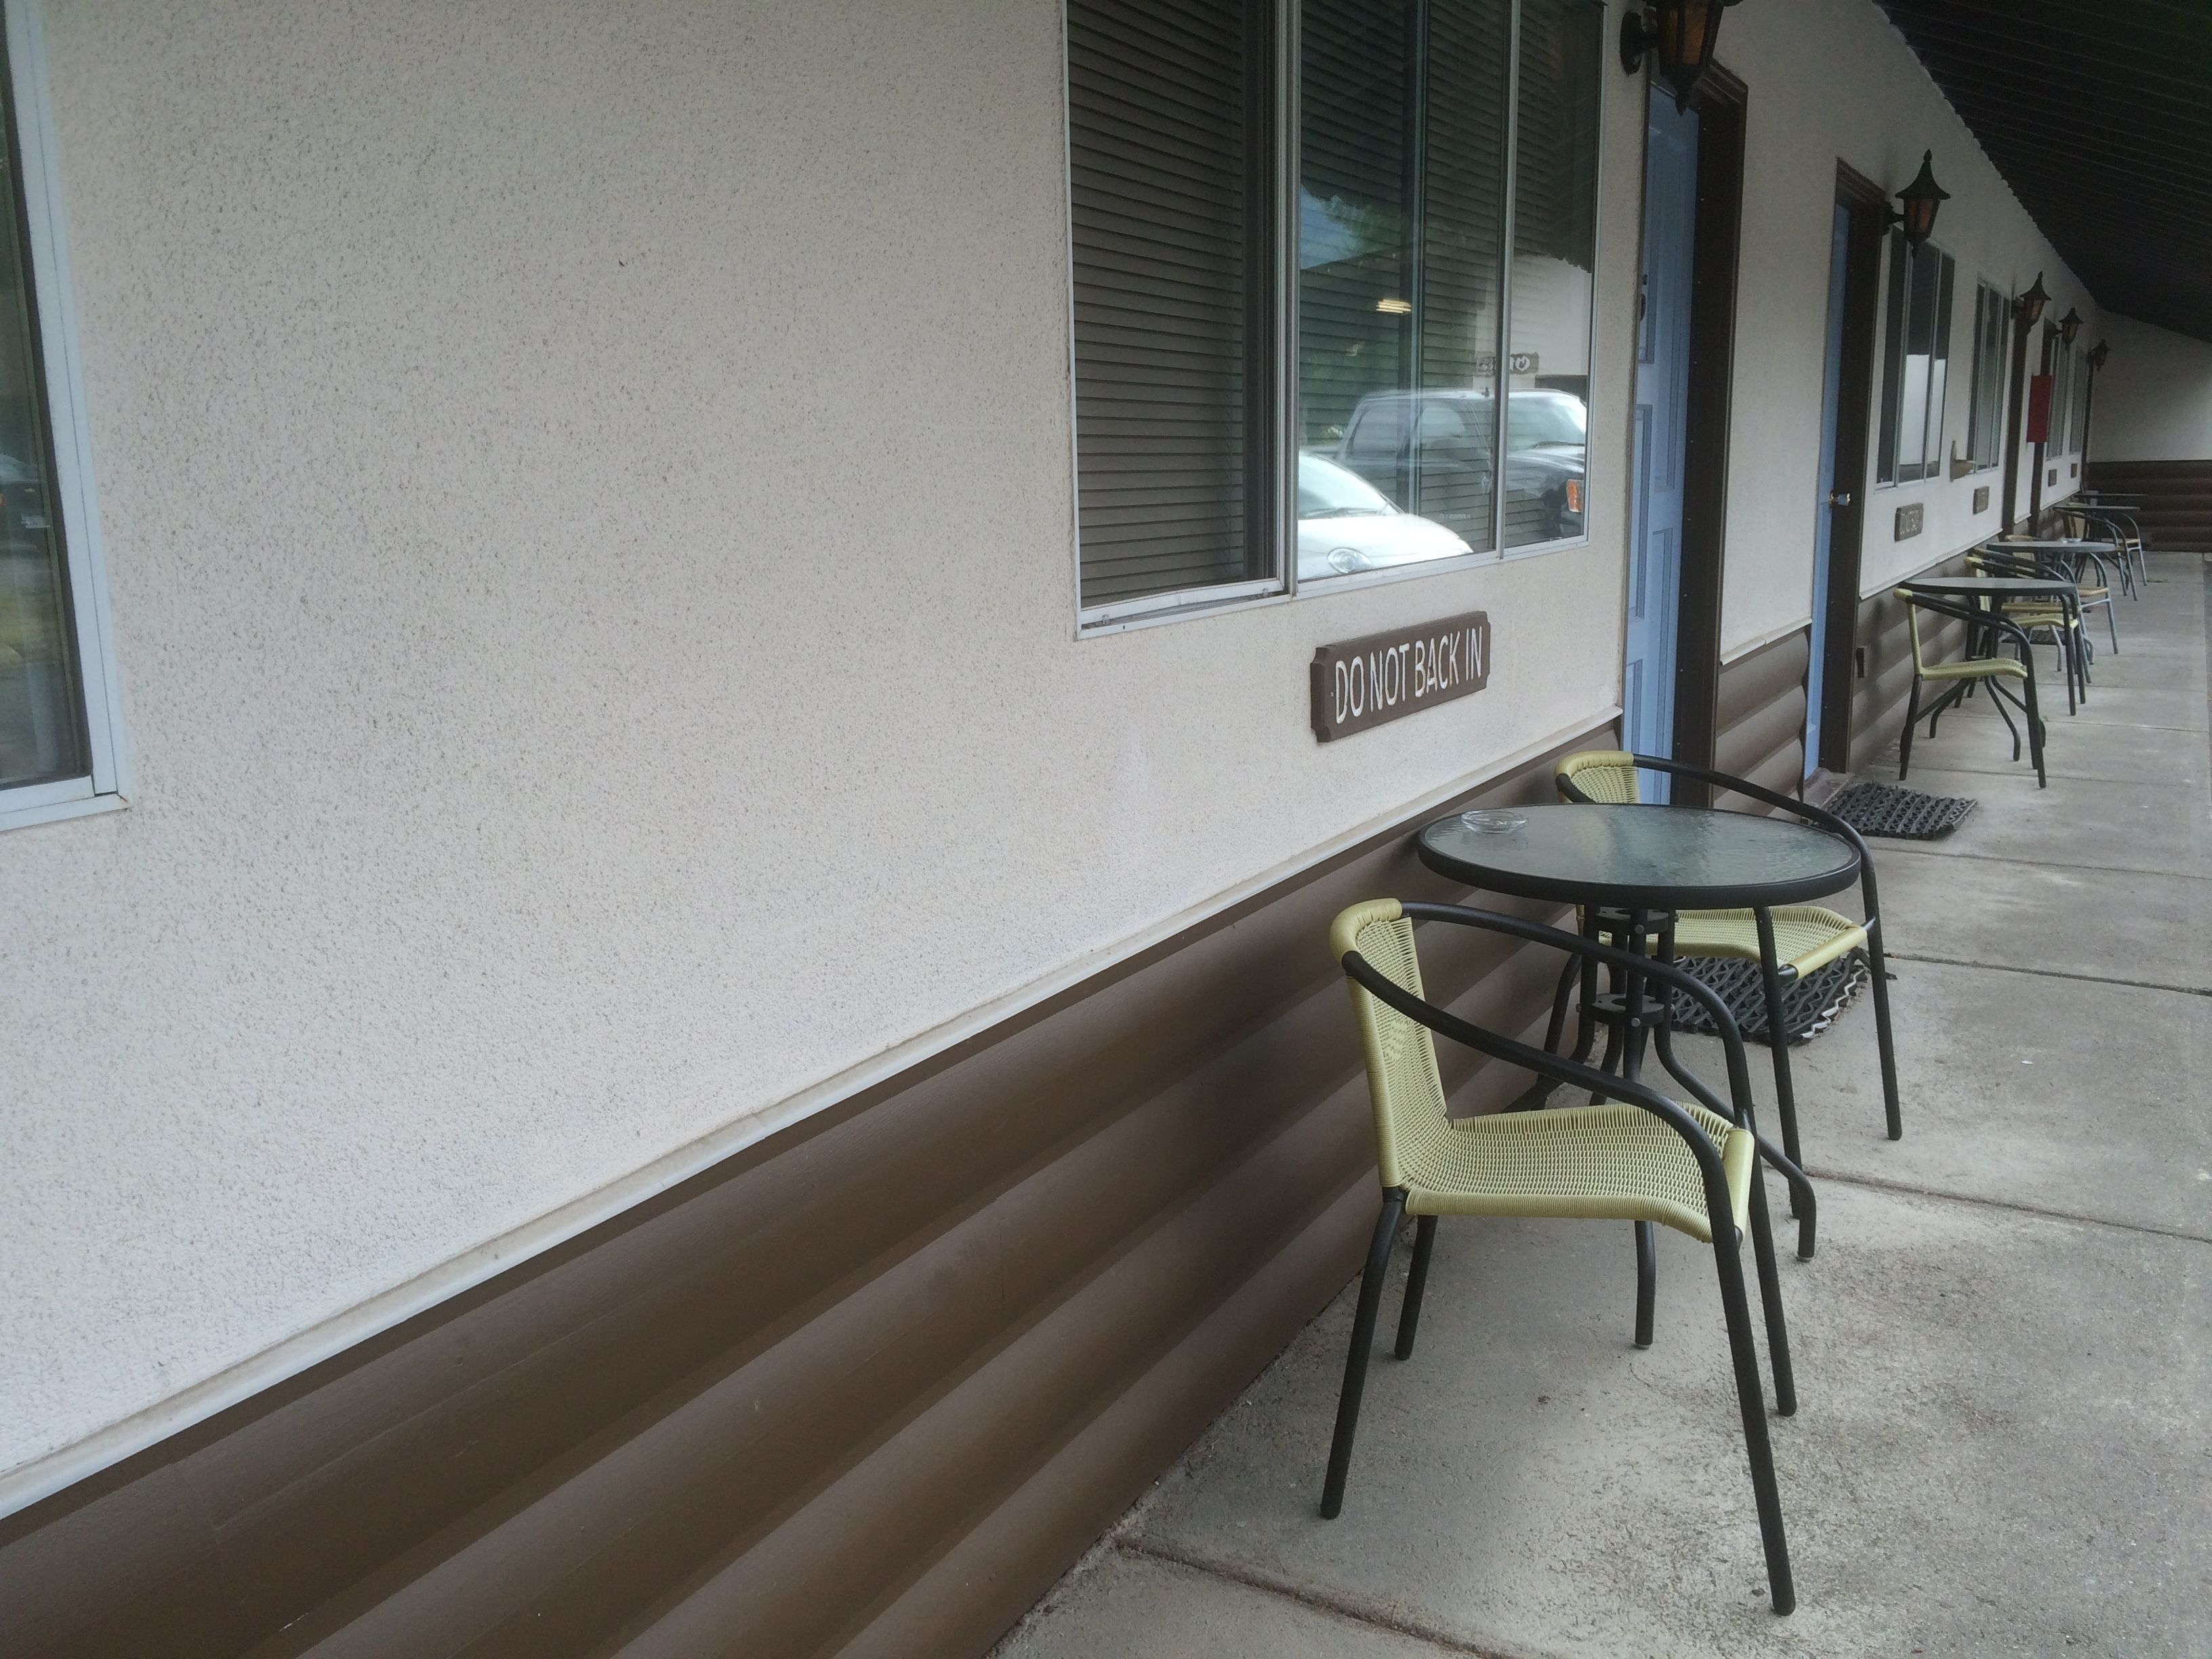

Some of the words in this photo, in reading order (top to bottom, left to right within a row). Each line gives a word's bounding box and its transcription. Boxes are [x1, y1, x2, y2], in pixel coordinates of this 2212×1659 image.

[1335, 655, 1364, 724] DO
[1370, 643, 1410, 712] NOT
[1414, 630, 1460, 697] BACK
[1465, 626, 1482, 681] IN
